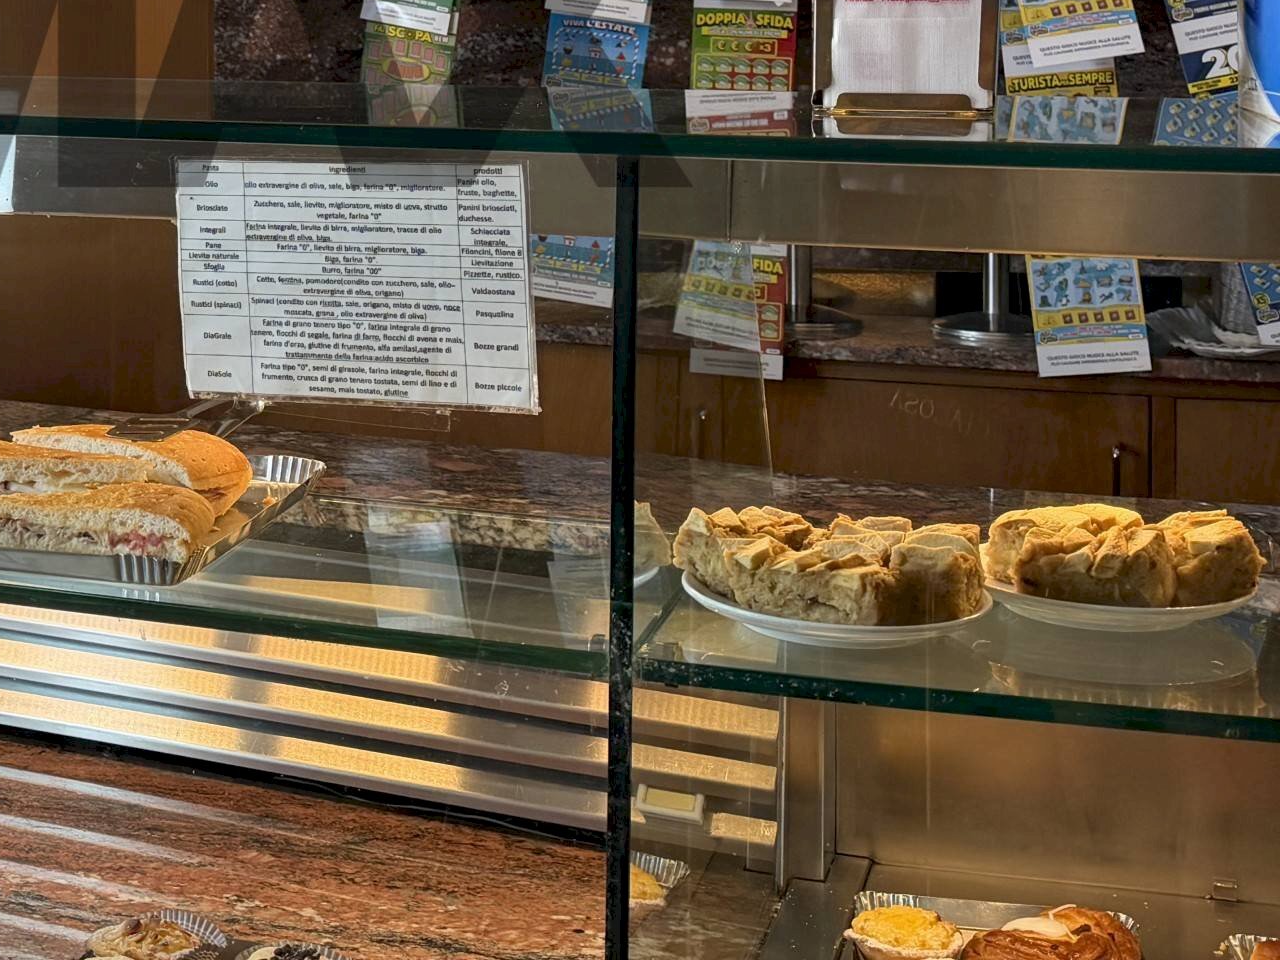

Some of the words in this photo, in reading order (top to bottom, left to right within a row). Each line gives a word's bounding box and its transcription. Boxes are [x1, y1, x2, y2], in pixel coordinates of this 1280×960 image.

[696, 13, 746, 27] DOPPIA
[755, 13, 793, 29] SFIDA
[1068, 70, 1113, 87] SEMPRE
